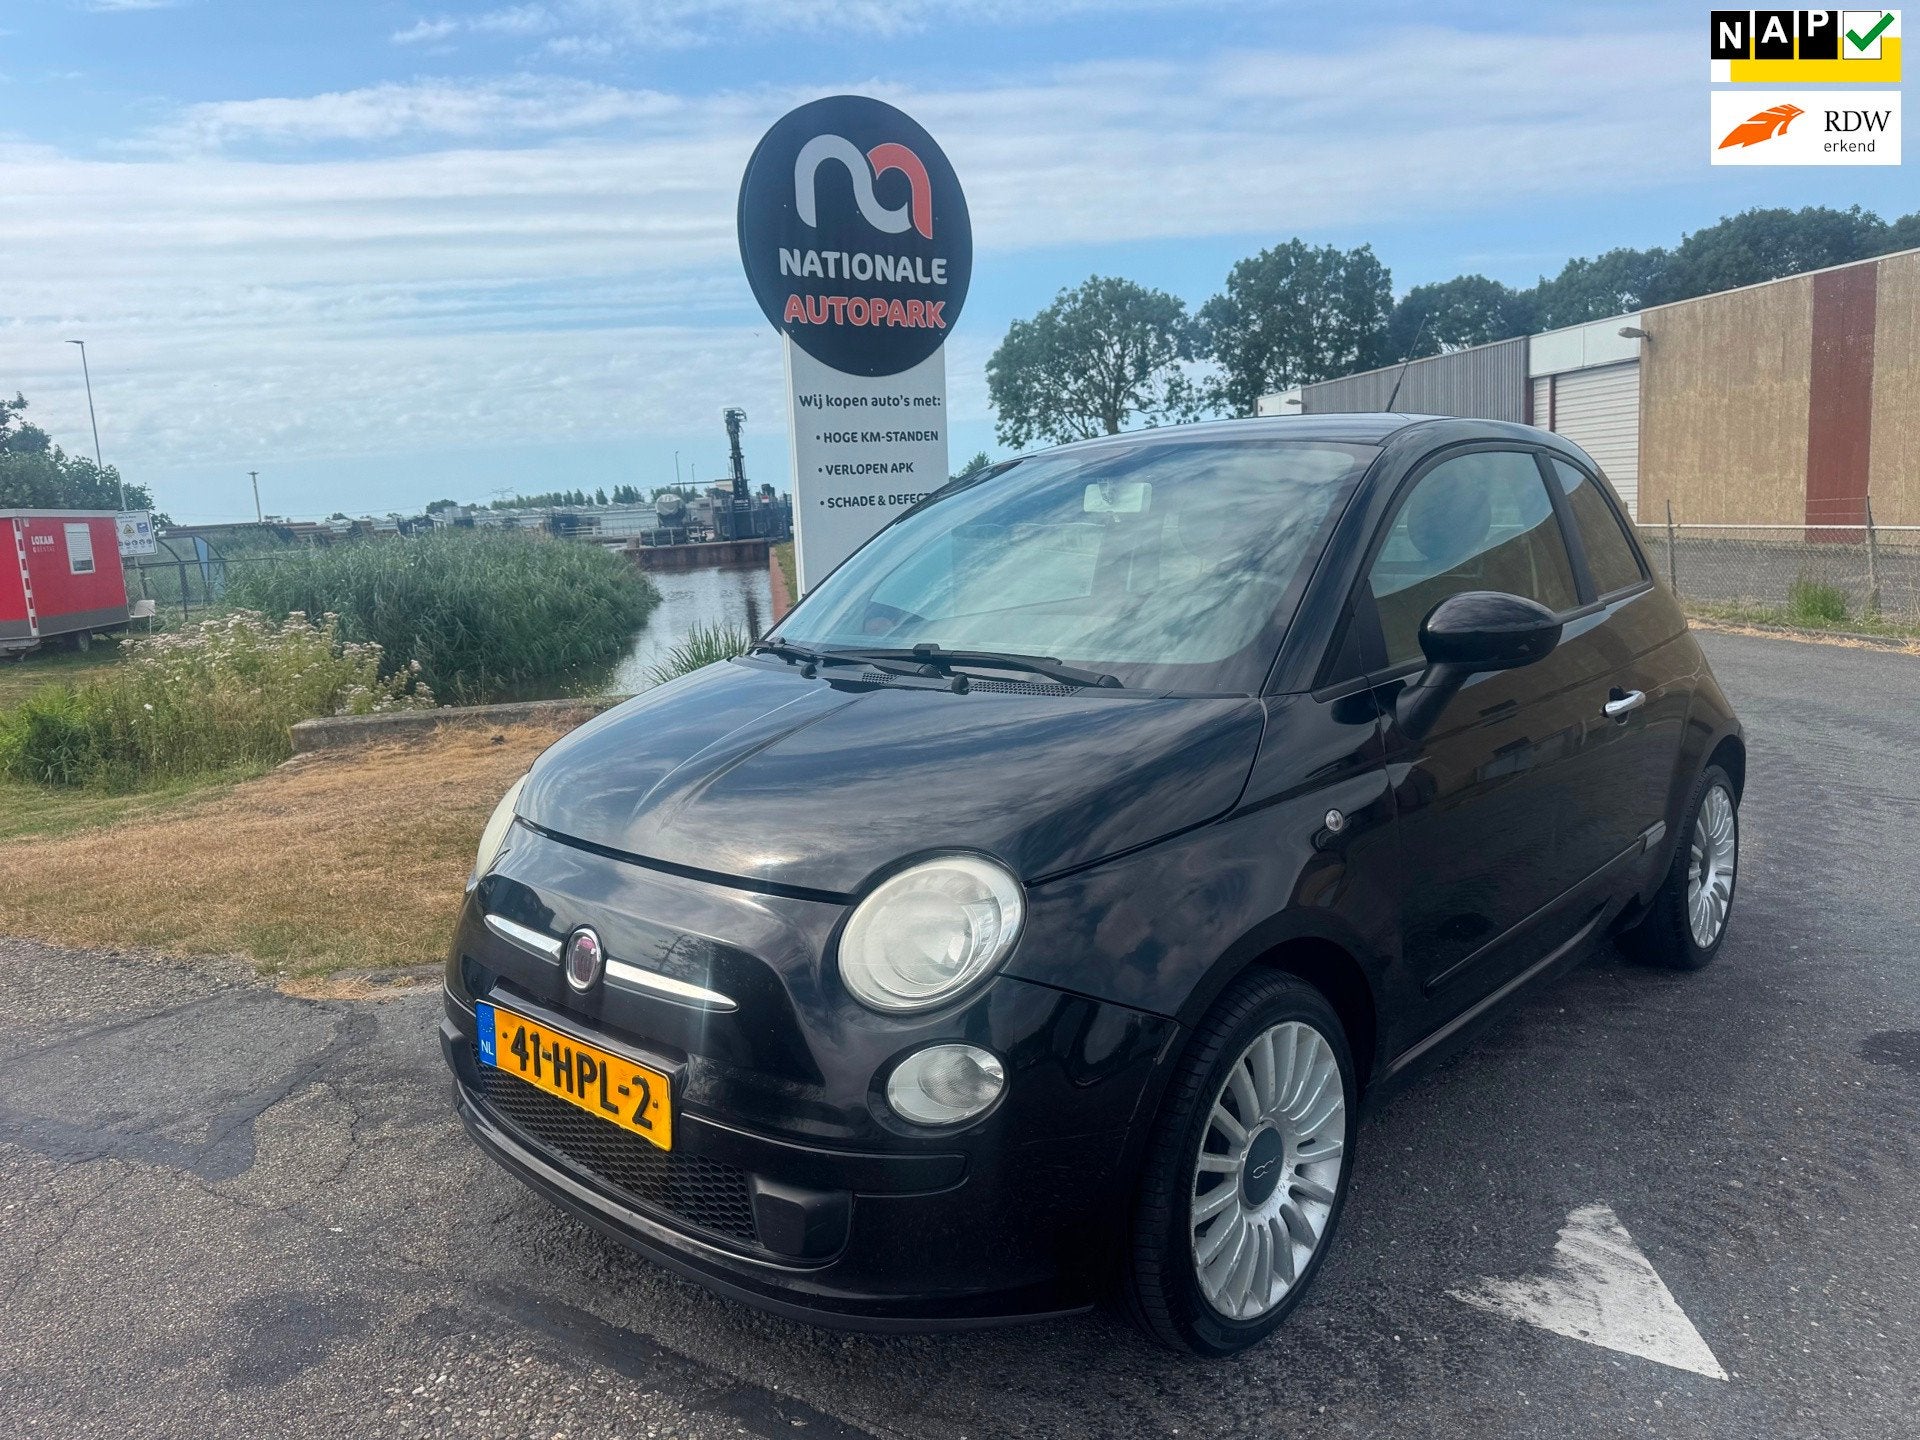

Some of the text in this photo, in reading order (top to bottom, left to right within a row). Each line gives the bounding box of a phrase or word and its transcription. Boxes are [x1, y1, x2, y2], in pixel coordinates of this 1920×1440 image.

[779, 248, 948, 285] NATIONALE
[783, 294, 947, 329] AUTOPARK
[799, 394, 941, 410] Wij kopen auto's met:
[823, 431, 939, 443] HOGE KM-STANDEN
[825, 462, 914, 475] VERLOPEN APK
[827, 496, 875, 508] SCHADE
[877, 495, 886, 506] &
[481, 1039, 494, 1056] NL
[510, 1025, 653, 1130] 41-HPL-2
